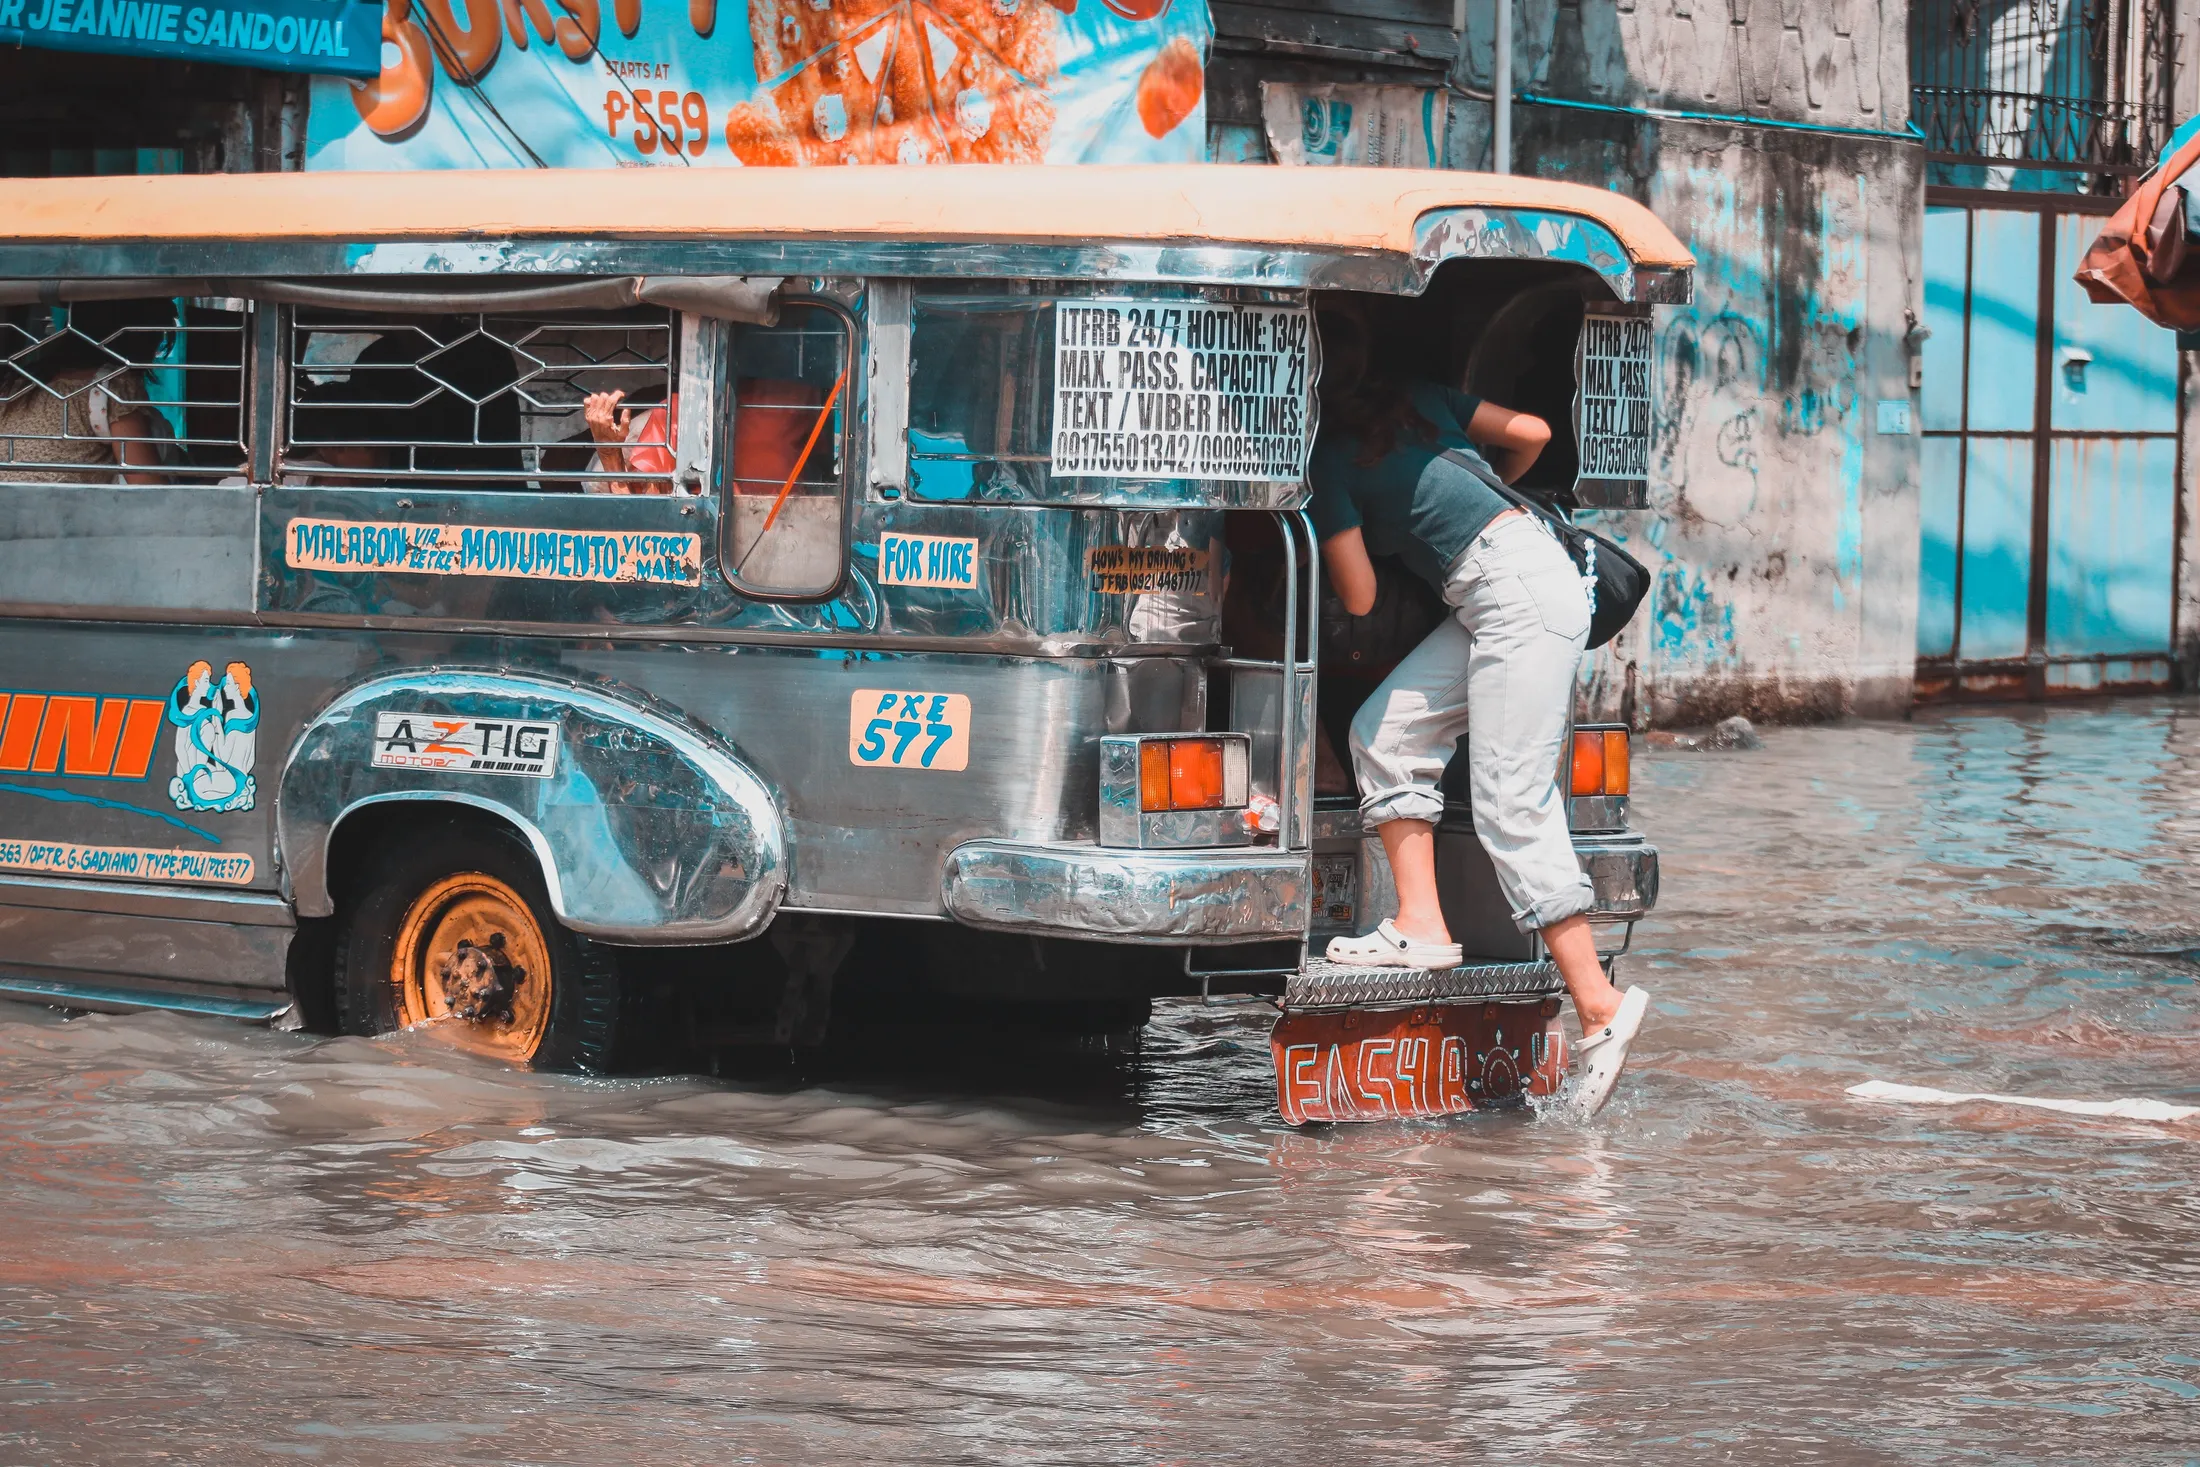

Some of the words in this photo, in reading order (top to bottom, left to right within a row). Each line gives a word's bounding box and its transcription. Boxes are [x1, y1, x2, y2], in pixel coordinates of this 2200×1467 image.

[28, 0, 182, 42] JEANNIE
[183, 7, 350, 57] SANDOVAL
[606, 60, 650, 79] STARTS
[654, 63, 670, 80] AT
[1061, 308, 1120, 347] LTFRB
[1127, 308, 1184, 348] 24/7
[1187, 310, 1266, 350] HOTLINE:
[1270, 314, 1307, 353] 1342
[1586, 319, 1621, 357] LTFRB
[1060, 350, 1110, 388] MAX.
[1117, 351, 1184, 391] PASS.
[1191, 352, 1278, 394] CAPACITY
[1287, 356, 1304, 395] 21
[1585, 359, 1615, 397] MAX.
[1619, 361, 1647, 399] PASS.
[1060, 391, 1112, 430] TEXT
[1138, 393, 1211, 433] VIBER
[1217, 395, 1303, 436] HOTLINES:
[1585, 398, 1616, 436] TEXT
[297, 525, 406, 567] MALABON
[414, 528, 440, 548] VIA
[461, 528, 618, 579] MONUMENTO
[623, 535, 693, 556] VICTORY
[636, 558, 688, 581] MALL
[884, 538, 924, 583] FOR
[928, 541, 974, 583] HIRE
[1128, 550, 1145, 570] MY
[1147, 551, 1186, 569] DRIVING
[877, 693, 949, 723] PXE
[857, 718, 952, 768] 577
